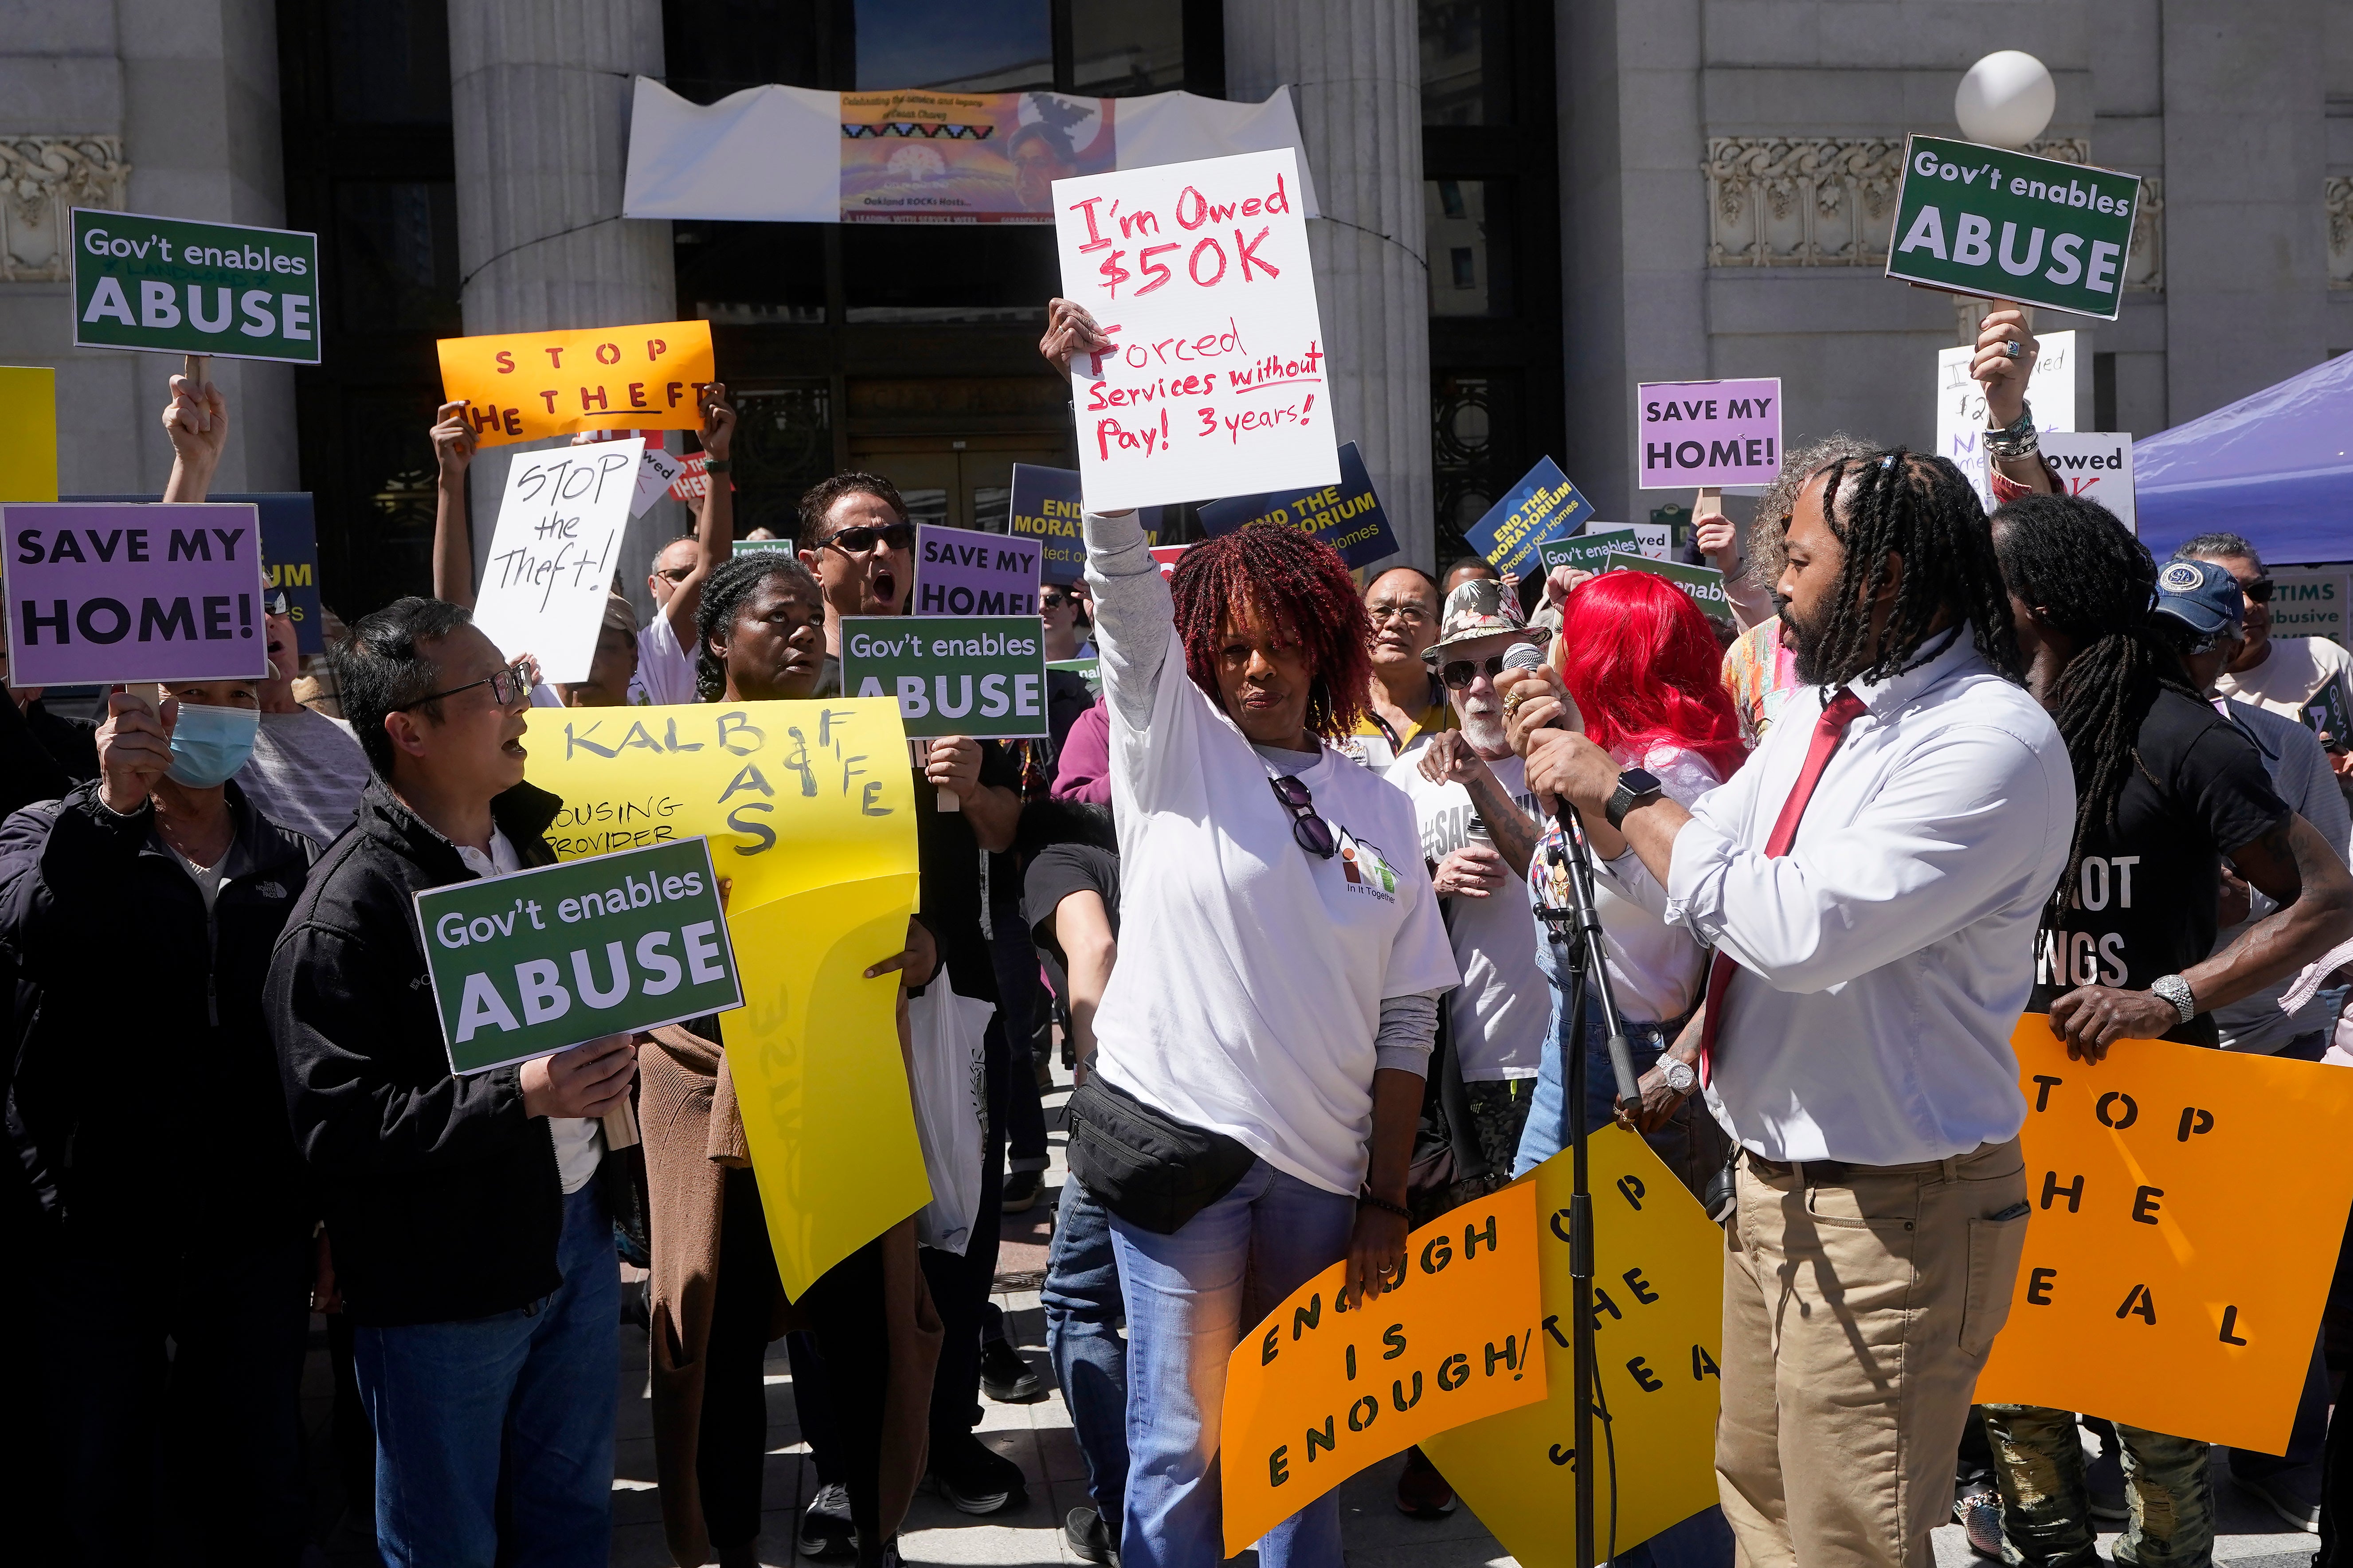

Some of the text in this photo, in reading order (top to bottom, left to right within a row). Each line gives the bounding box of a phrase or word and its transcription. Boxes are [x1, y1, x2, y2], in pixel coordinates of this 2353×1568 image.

[1915, 151, 2129, 217] Gov't enables
[1070, 172, 1290, 253] I'm Owed
[84, 228, 307, 276] Gov't enables
[1098, 226, 1280, 300] $50K
[1898, 204, 2120, 294] ABUSE
[82, 276, 311, 341] ABUSE
[495, 338, 667, 374] STOP
[1087, 340, 1323, 411] Services without
[1097, 407, 1169, 461] Pay!
[1198, 407, 1217, 437] 3
[1646, 398, 1772, 422] SAVE MY
[517, 454, 628, 506] STOP
[643, 450, 675, 480] wed
[1647, 438, 1774, 469] HOME!
[2047, 447, 2122, 469] owed
[534, 510, 580, 540] the
[1290, 491, 1376, 534] ORIUM
[1291, 485, 1340, 517] THE
[1486, 481, 1573, 566] MORATORIUM
[1493, 486, 1550, 543] END THE
[18, 528, 246, 565] SAVE MY
[924, 540, 1034, 574] SAVE MY
[1500, 500, 1579, 575] Protect our Homes
[1546, 539, 1636, 566] Gov't enables
[494, 528, 615, 614] Theft!
[22, 593, 253, 646] HOME!
[850, 633, 1036, 658] Gov't enables
[550, 796, 684, 830] OUSING
[436, 870, 704, 949] Gov't enables
[1347, 884, 1395, 904] In It Together
[2057, 856, 2140, 911] OT
[455, 920, 726, 1044] ABUSE
[2032, 929, 2128, 988] NGS
[2032, 1075, 2215, 1142] TOP
[2040, 1170, 2165, 1225] HE
[1542, 1267, 1660, 1348] THE
[2027, 1267, 2247, 1347] EAL
[1345, 1323, 1407, 1381] IS
[1269, 1328, 1532, 1488] ENOUGH!
